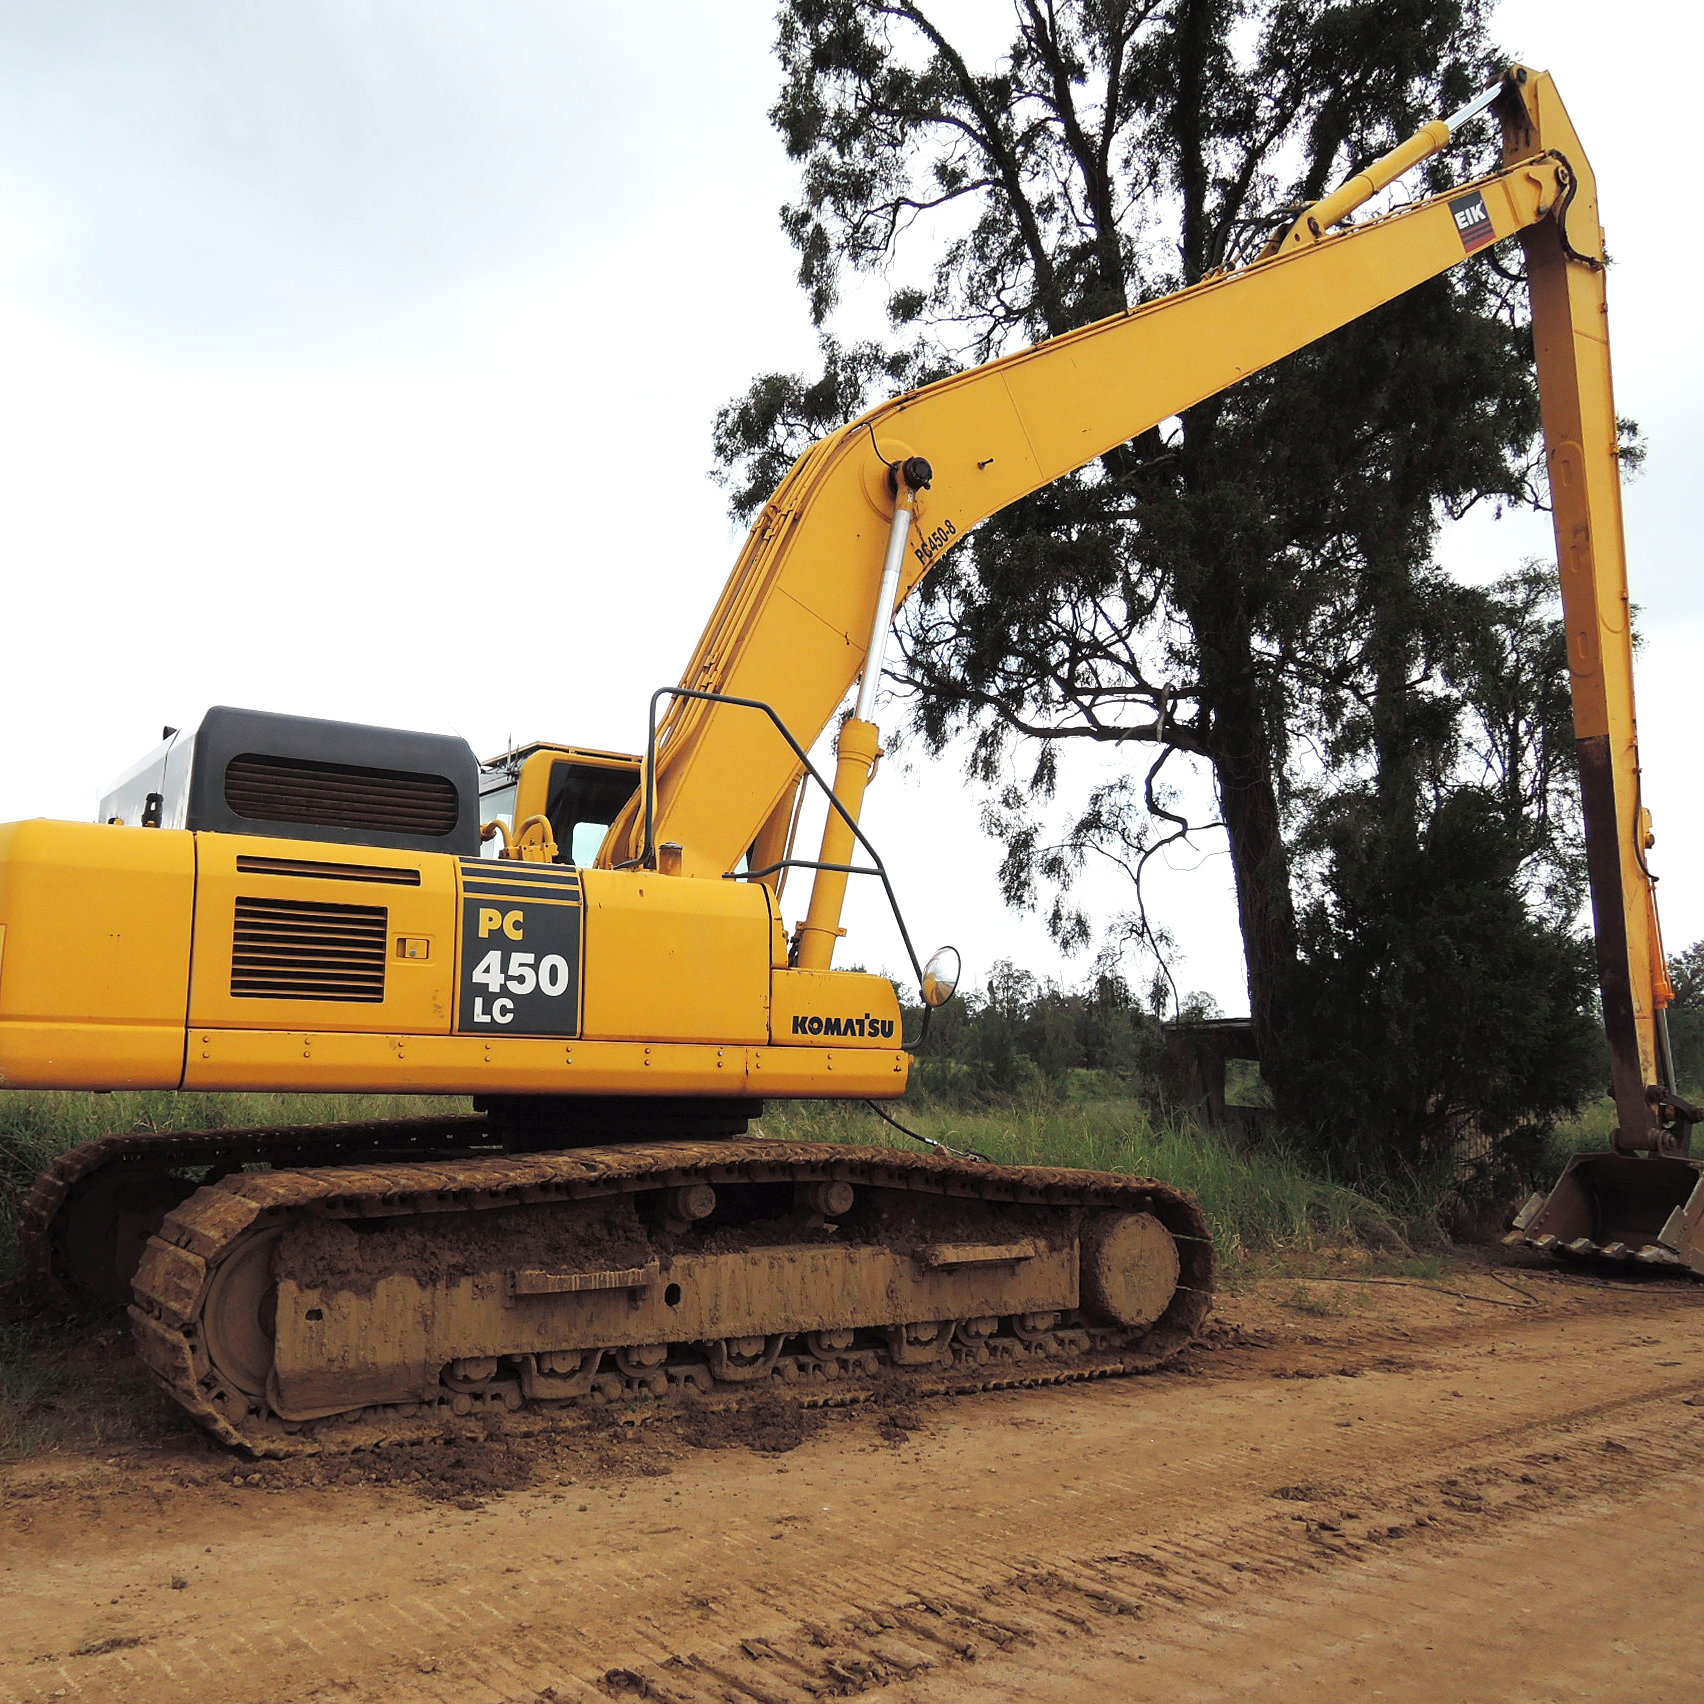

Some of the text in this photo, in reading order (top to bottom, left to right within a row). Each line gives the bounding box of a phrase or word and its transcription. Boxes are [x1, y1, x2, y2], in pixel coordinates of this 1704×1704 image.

[1454, 201, 1487, 230] EIK
[914, 519, 957, 566] PC450-8
[478, 907, 524, 941] PC
[471, 950, 569, 997] 450
[473, 996, 514, 1024] LC
[791, 1013, 894, 1038] KOMATSU
